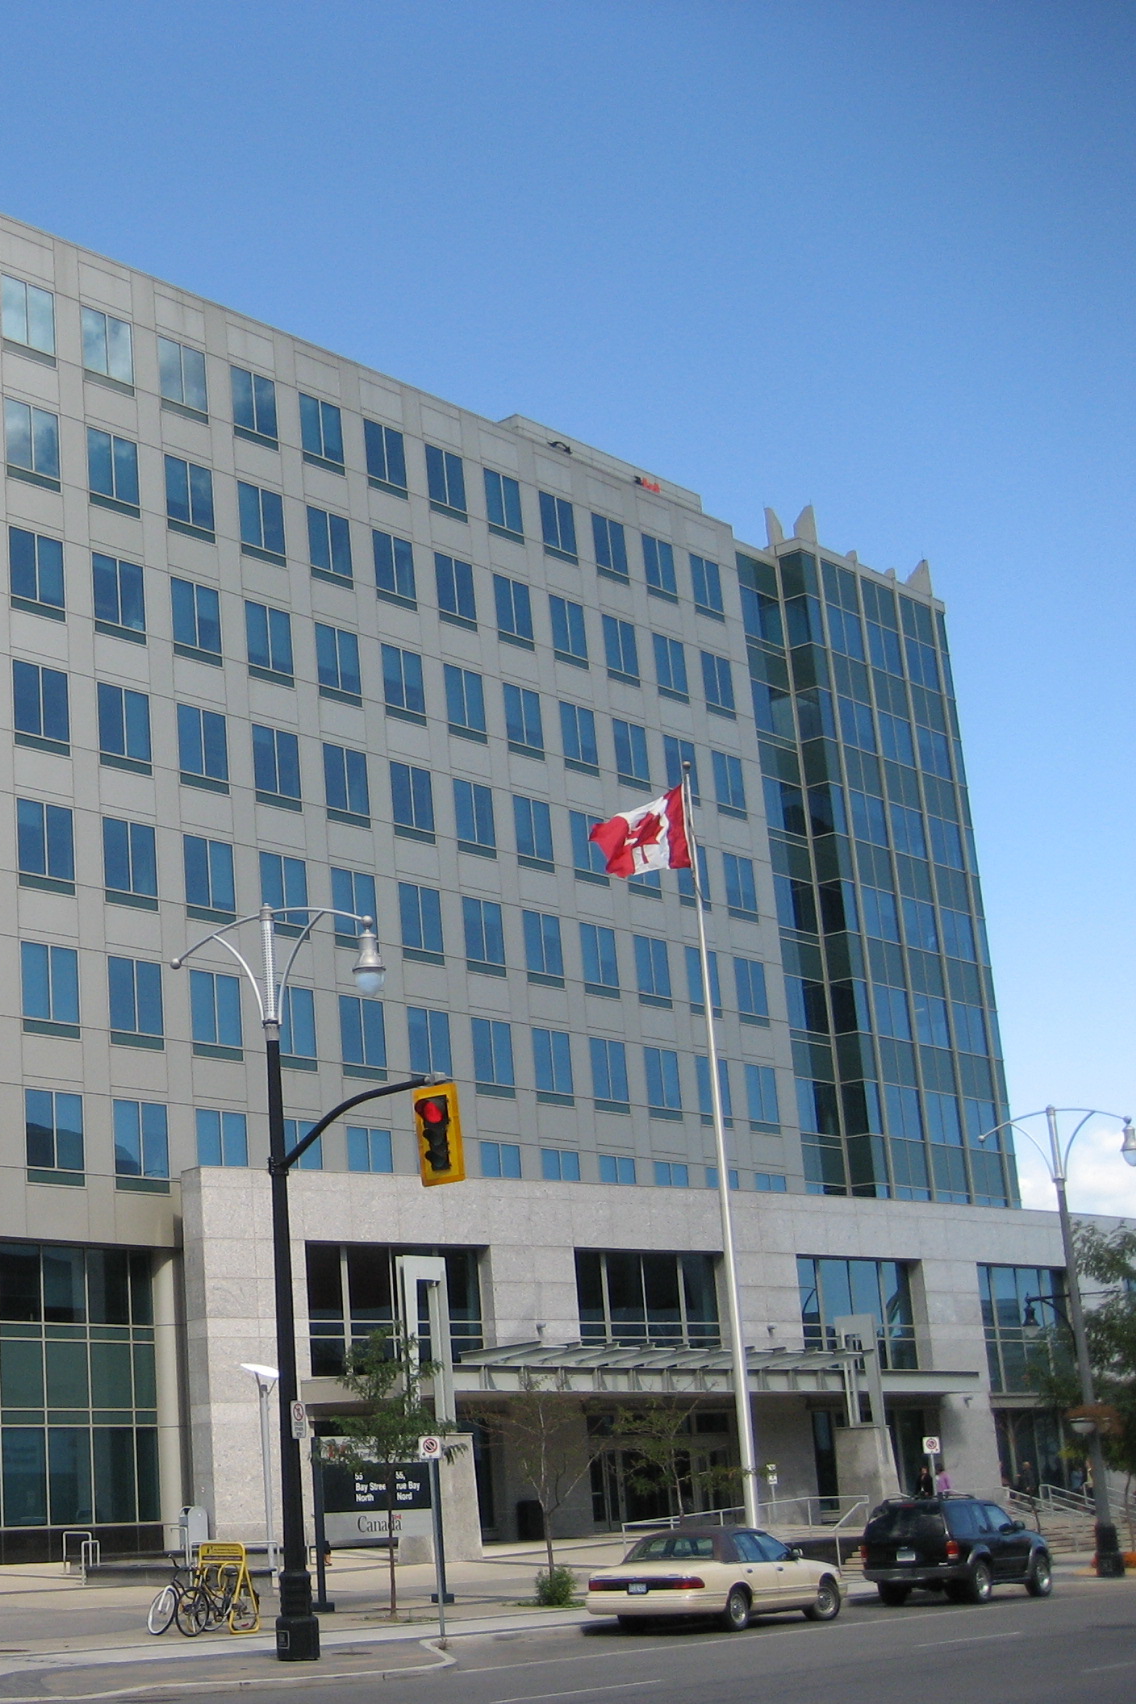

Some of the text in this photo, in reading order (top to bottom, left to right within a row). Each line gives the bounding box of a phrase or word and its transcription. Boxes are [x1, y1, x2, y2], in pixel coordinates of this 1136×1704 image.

[355, 1482, 387, 1493] Bay Stree
[408, 1481, 421, 1491] Bay
[356, 1493, 375, 1502] North
[396, 1492, 413, 1501] Nord
[357, 1514, 402, 1533] Canada
